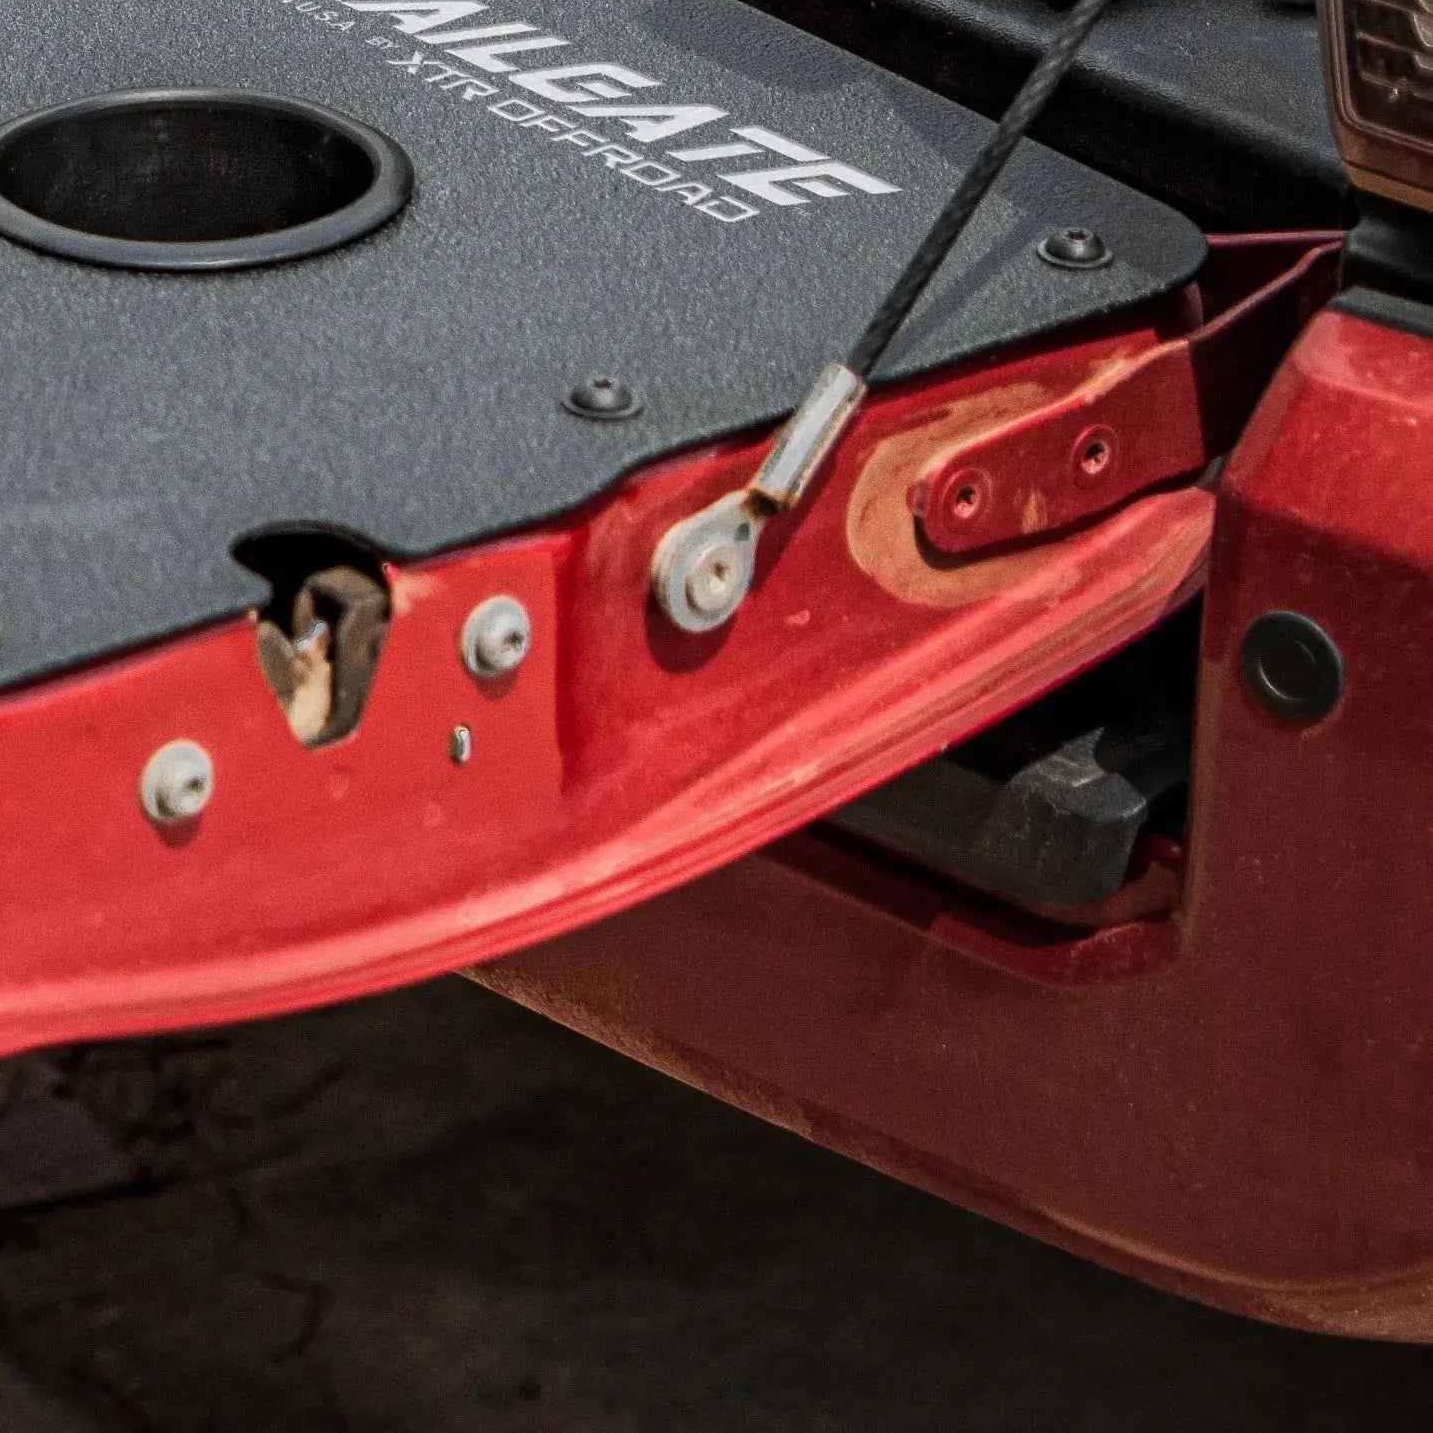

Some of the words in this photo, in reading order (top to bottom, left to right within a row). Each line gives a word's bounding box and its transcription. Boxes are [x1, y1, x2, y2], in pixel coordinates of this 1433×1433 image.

[365, 37, 400, 50] BY
[386, 50, 500, 101] XTR
[487, 99, 760, 222] OFFROAD
